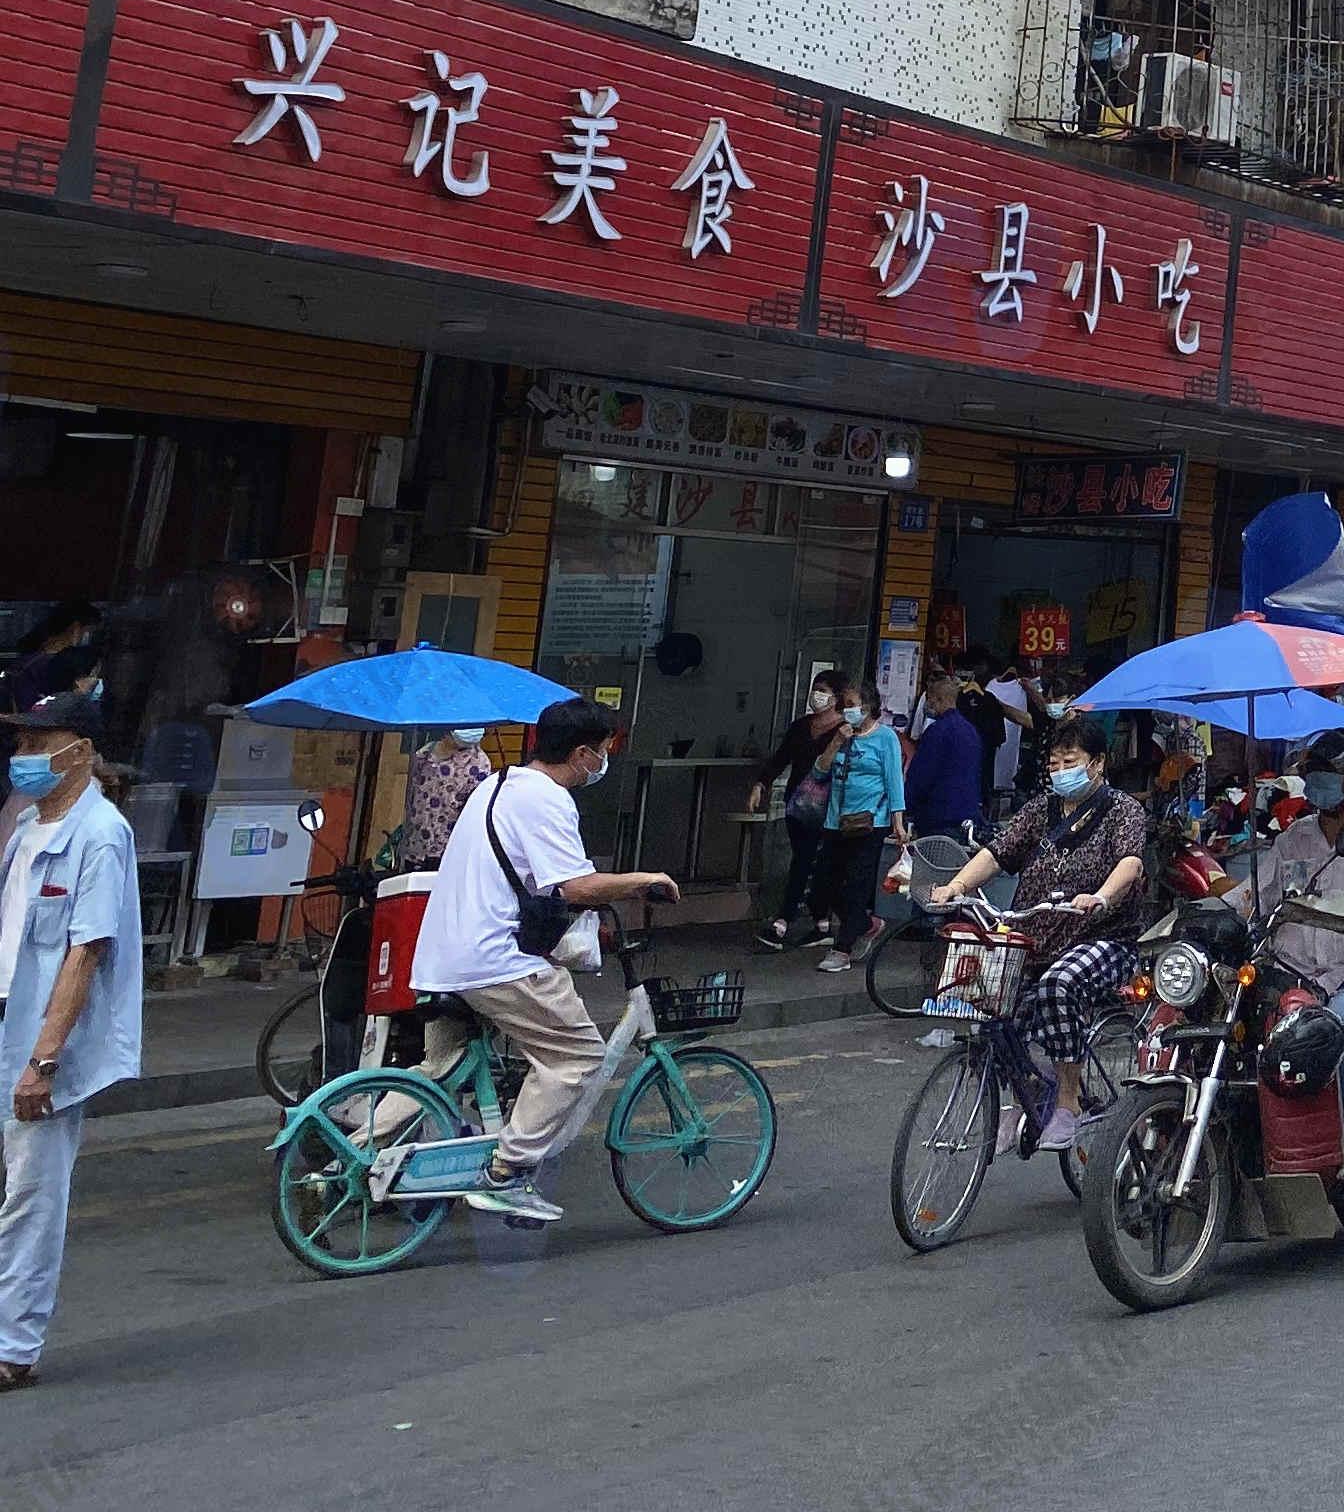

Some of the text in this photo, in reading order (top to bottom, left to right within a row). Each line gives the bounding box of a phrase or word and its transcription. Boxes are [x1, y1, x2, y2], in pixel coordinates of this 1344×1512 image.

[231, 15, 756, 259] 兴记美食
[870, 174, 1200, 354] 沙县小吃
